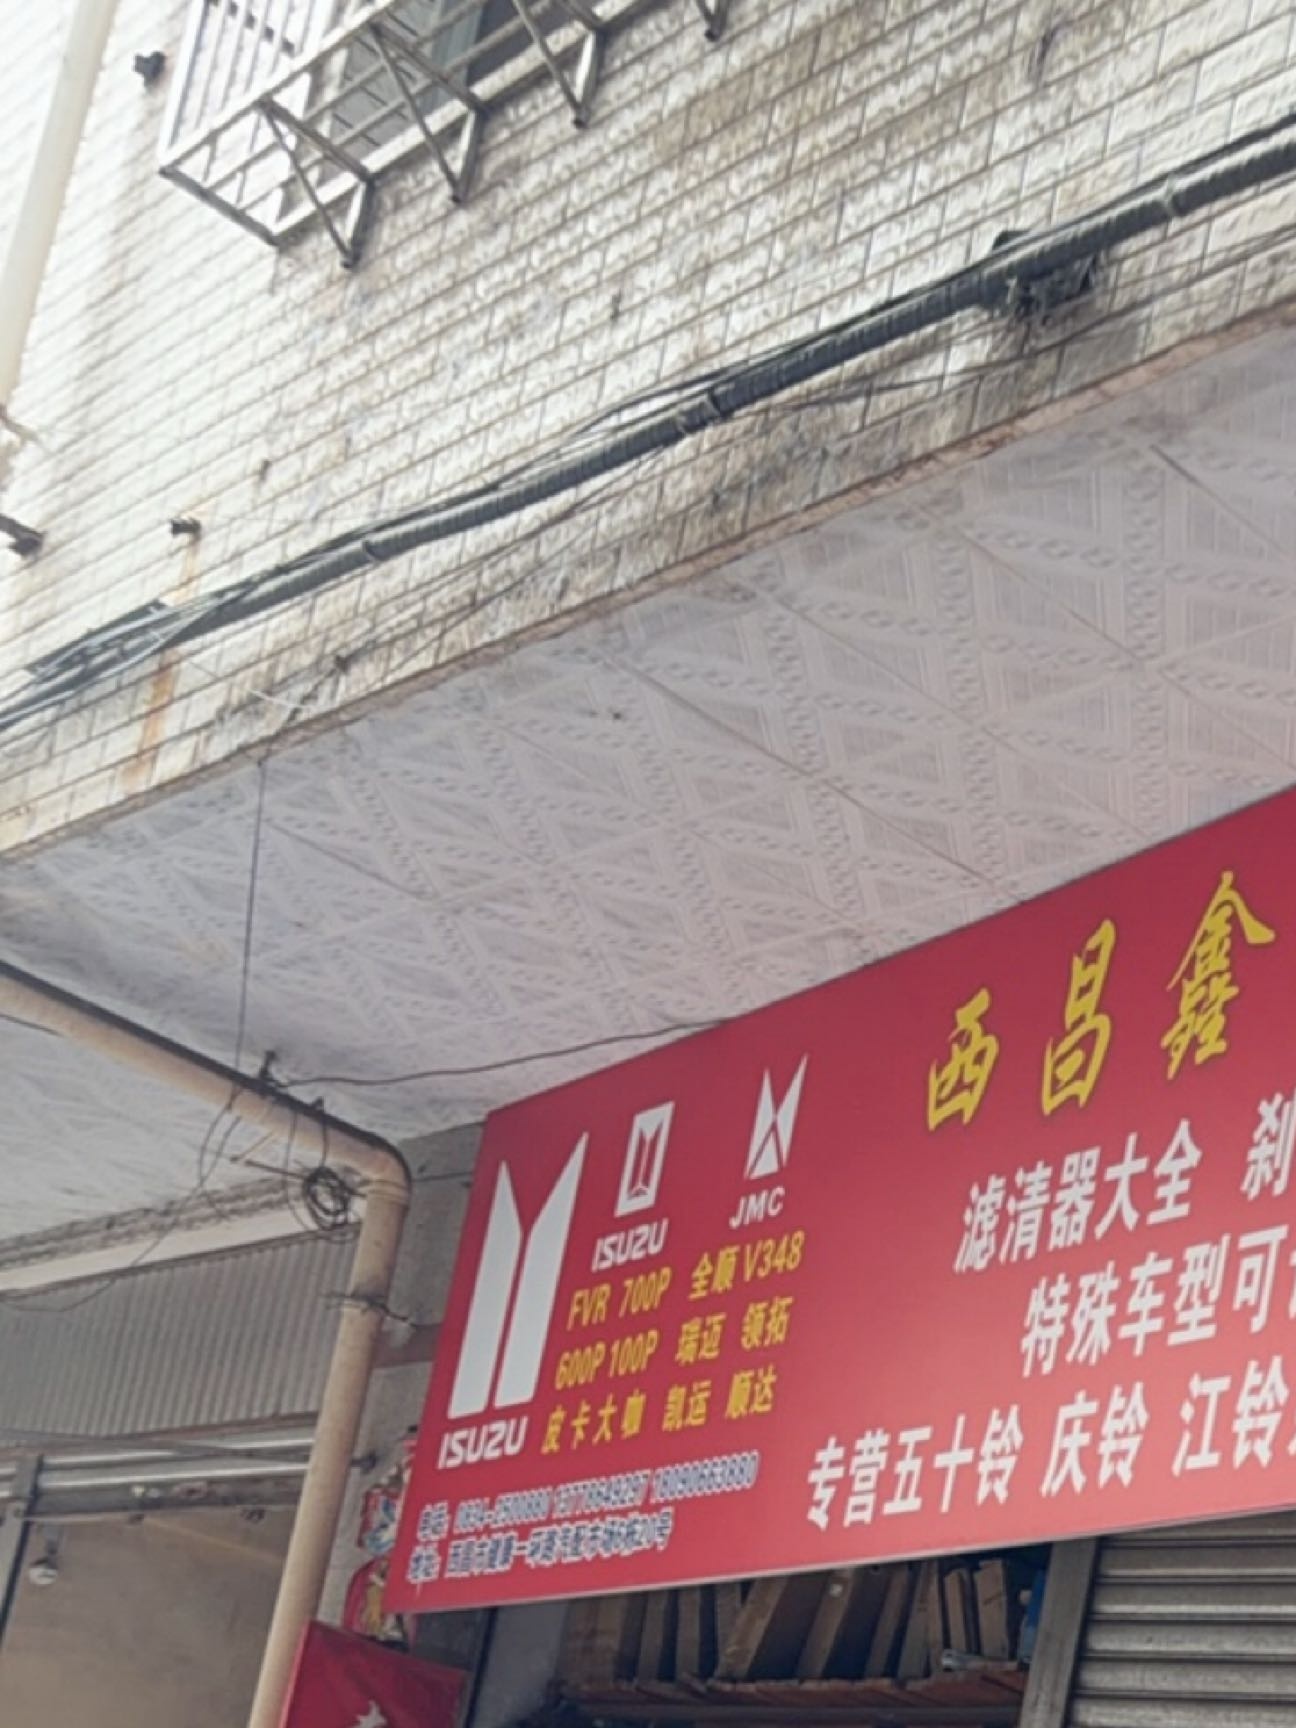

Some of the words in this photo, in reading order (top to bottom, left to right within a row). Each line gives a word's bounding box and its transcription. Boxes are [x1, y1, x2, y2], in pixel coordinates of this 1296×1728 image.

[729, 1187, 785, 1229] JMC
[954, 1119, 1202, 1273] 滤清器大全
[567, 1283, 611, 1331] FVR
[618, 1266, 671, 1319] 700P
[689, 1246, 737, 1301] 全顺
[743, 1230, 805, 1283] V348
[591, 1219, 669, 1272] ISUZU
[556, 1342, 605, 1390] 600P
[609, 1329, 658, 1377] 100P
[741, 1296, 794, 1350] 领拓
[662, 1379, 712, 1432] 凯运
[725, 1364, 777, 1420] 顺达
[437, 1417, 528, 1469] ISUZU
[807, 1404, 1024, 1530] 专营五十铃
[1039, 1380, 1150, 1498] 庆铃
